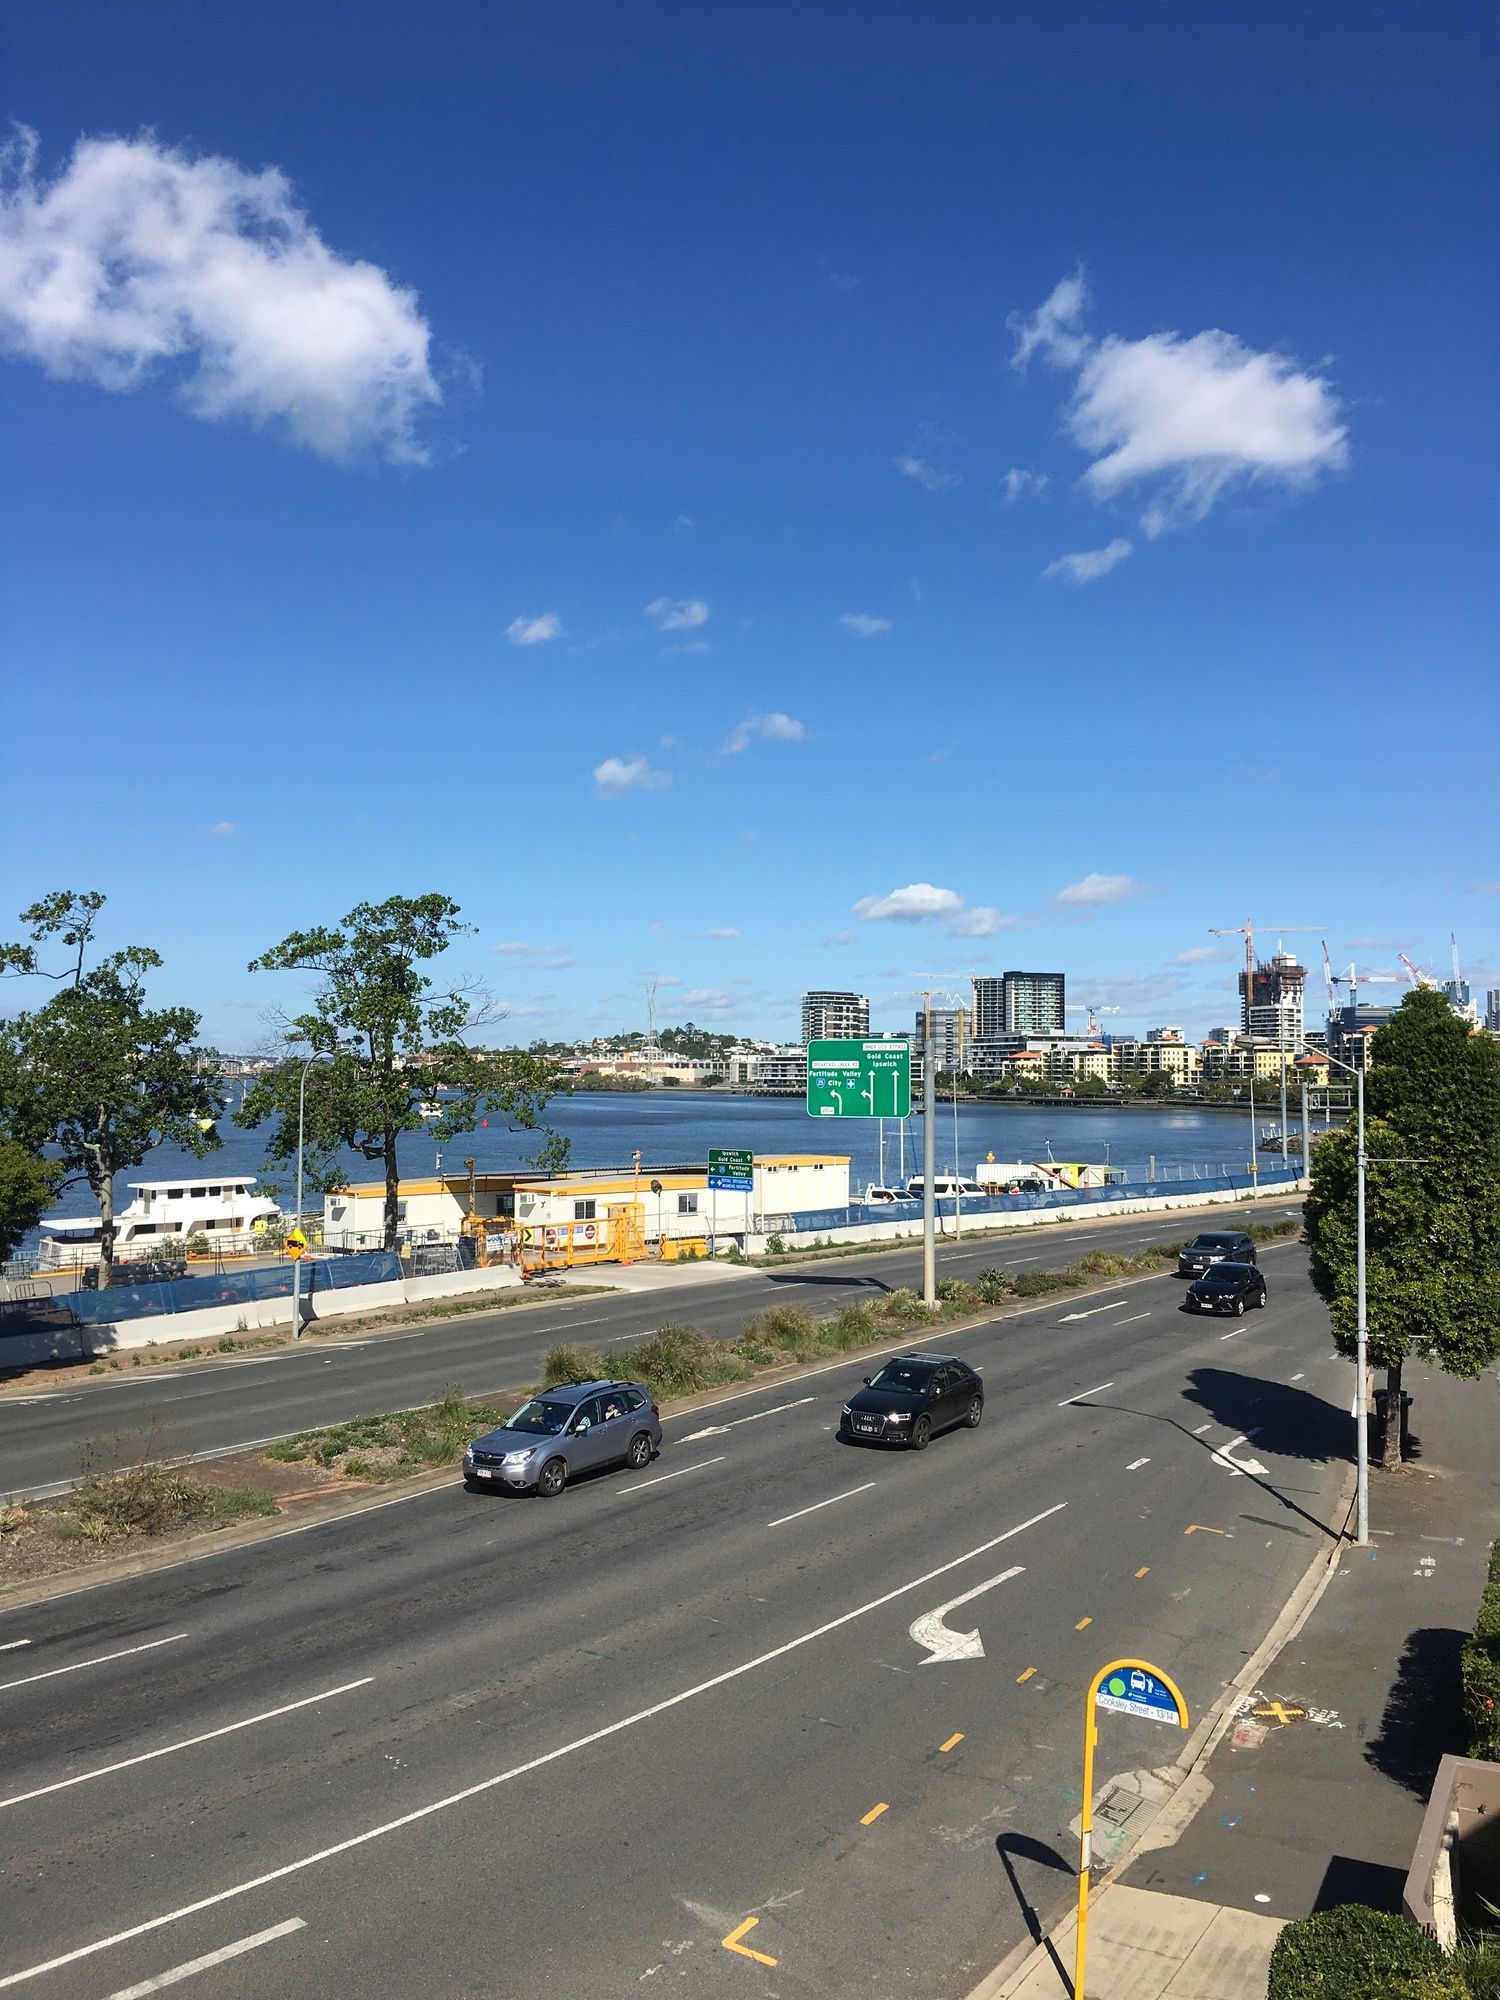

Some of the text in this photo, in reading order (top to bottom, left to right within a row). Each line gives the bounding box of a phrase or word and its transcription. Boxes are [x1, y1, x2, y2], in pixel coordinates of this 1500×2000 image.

[1099, 1694, 1127, 1711] Cooksley
[1130, 1702, 1149, 1714] Street
[1156, 1709, 1174, 1720] 13/14
